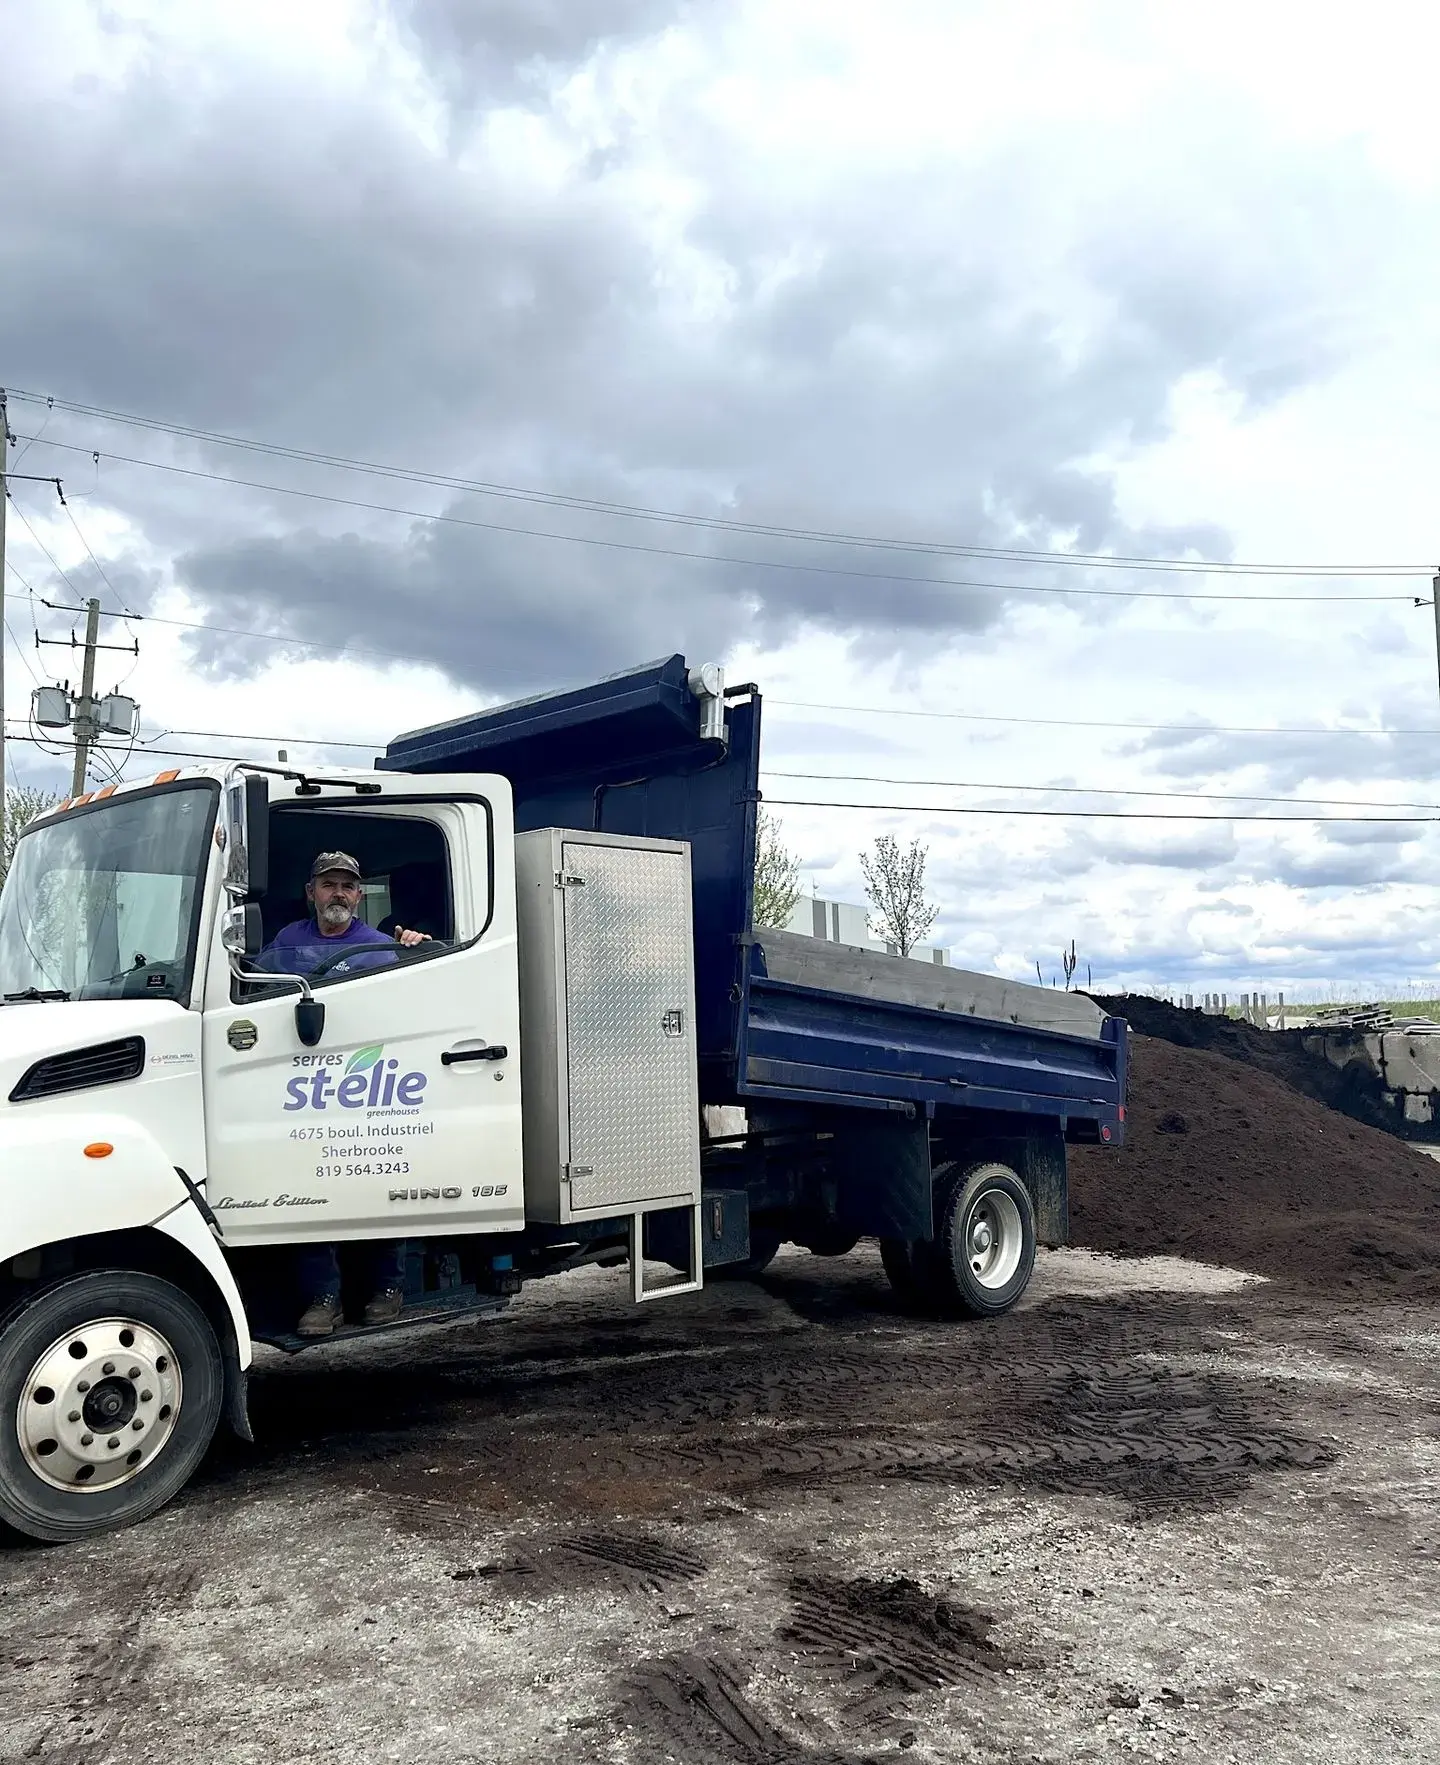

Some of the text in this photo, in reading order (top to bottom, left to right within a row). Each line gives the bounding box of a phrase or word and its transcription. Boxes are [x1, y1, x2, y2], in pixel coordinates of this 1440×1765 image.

[292, 1054, 343, 1067] serres
[366, 1107, 420, 1119] greenhouses
[289, 1122, 434, 1140] 4675 boul. Industriel
[321, 1143, 404, 1158] Sherbrooke
[315, 1161, 410, 1178] 819 564.3243
[388, 1184, 508, 1201] HINO 185
[211, 1193, 329, 1210] Limited Edition
